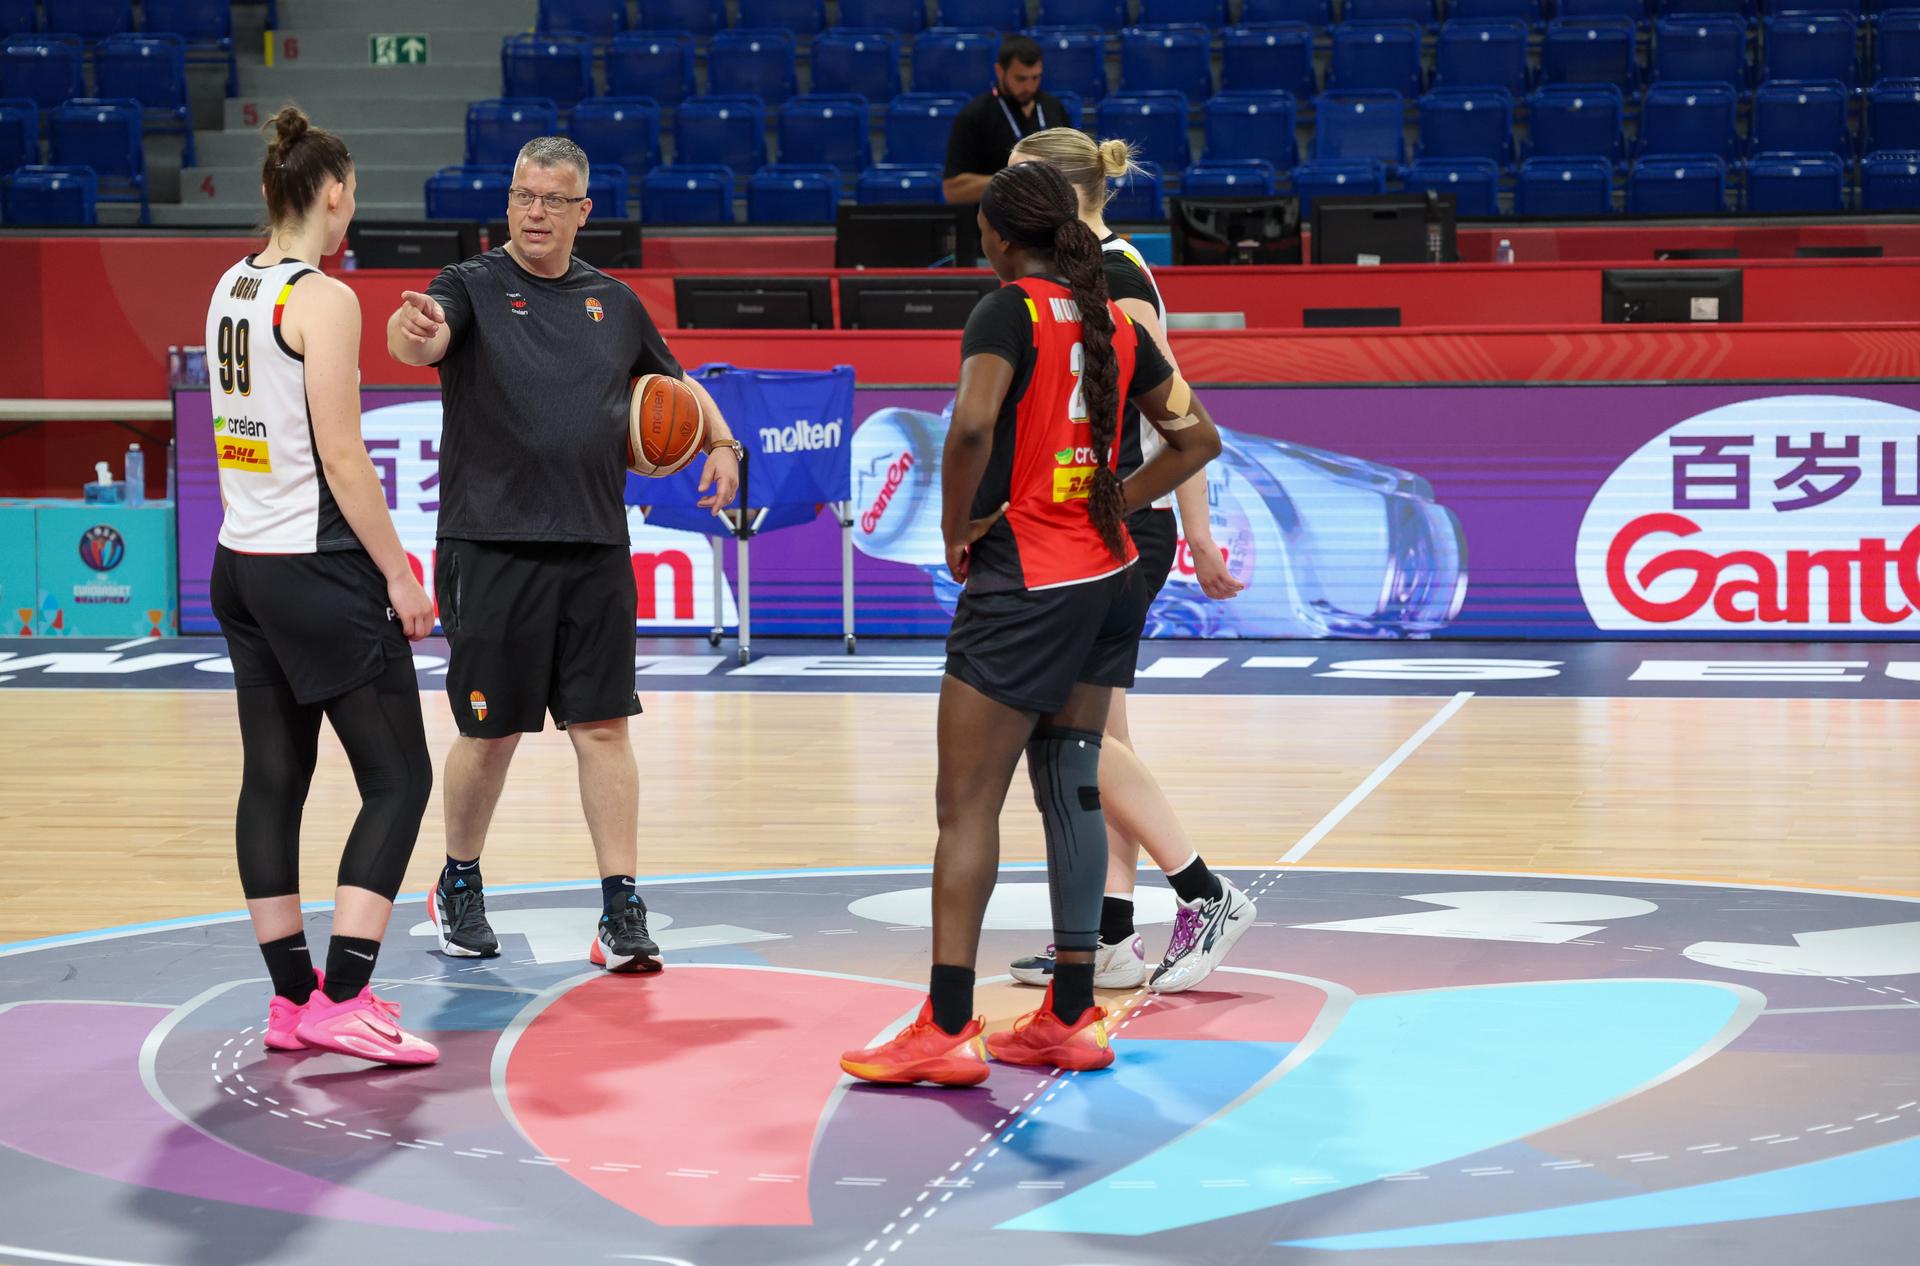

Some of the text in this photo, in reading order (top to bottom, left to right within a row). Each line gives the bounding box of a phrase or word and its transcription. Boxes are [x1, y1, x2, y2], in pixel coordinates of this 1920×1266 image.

[284, 38, 298, 59] 6
[242, 103, 259, 126] 5
[202, 176, 216, 198] 4
[230, 275, 262, 300] JORIS
[218, 316, 251, 397] 99
[653, 391, 665, 434] molten
[228, 416, 267, 438] crelan
[759, 419, 842, 454] molten
[222, 444, 259, 465] DHL
